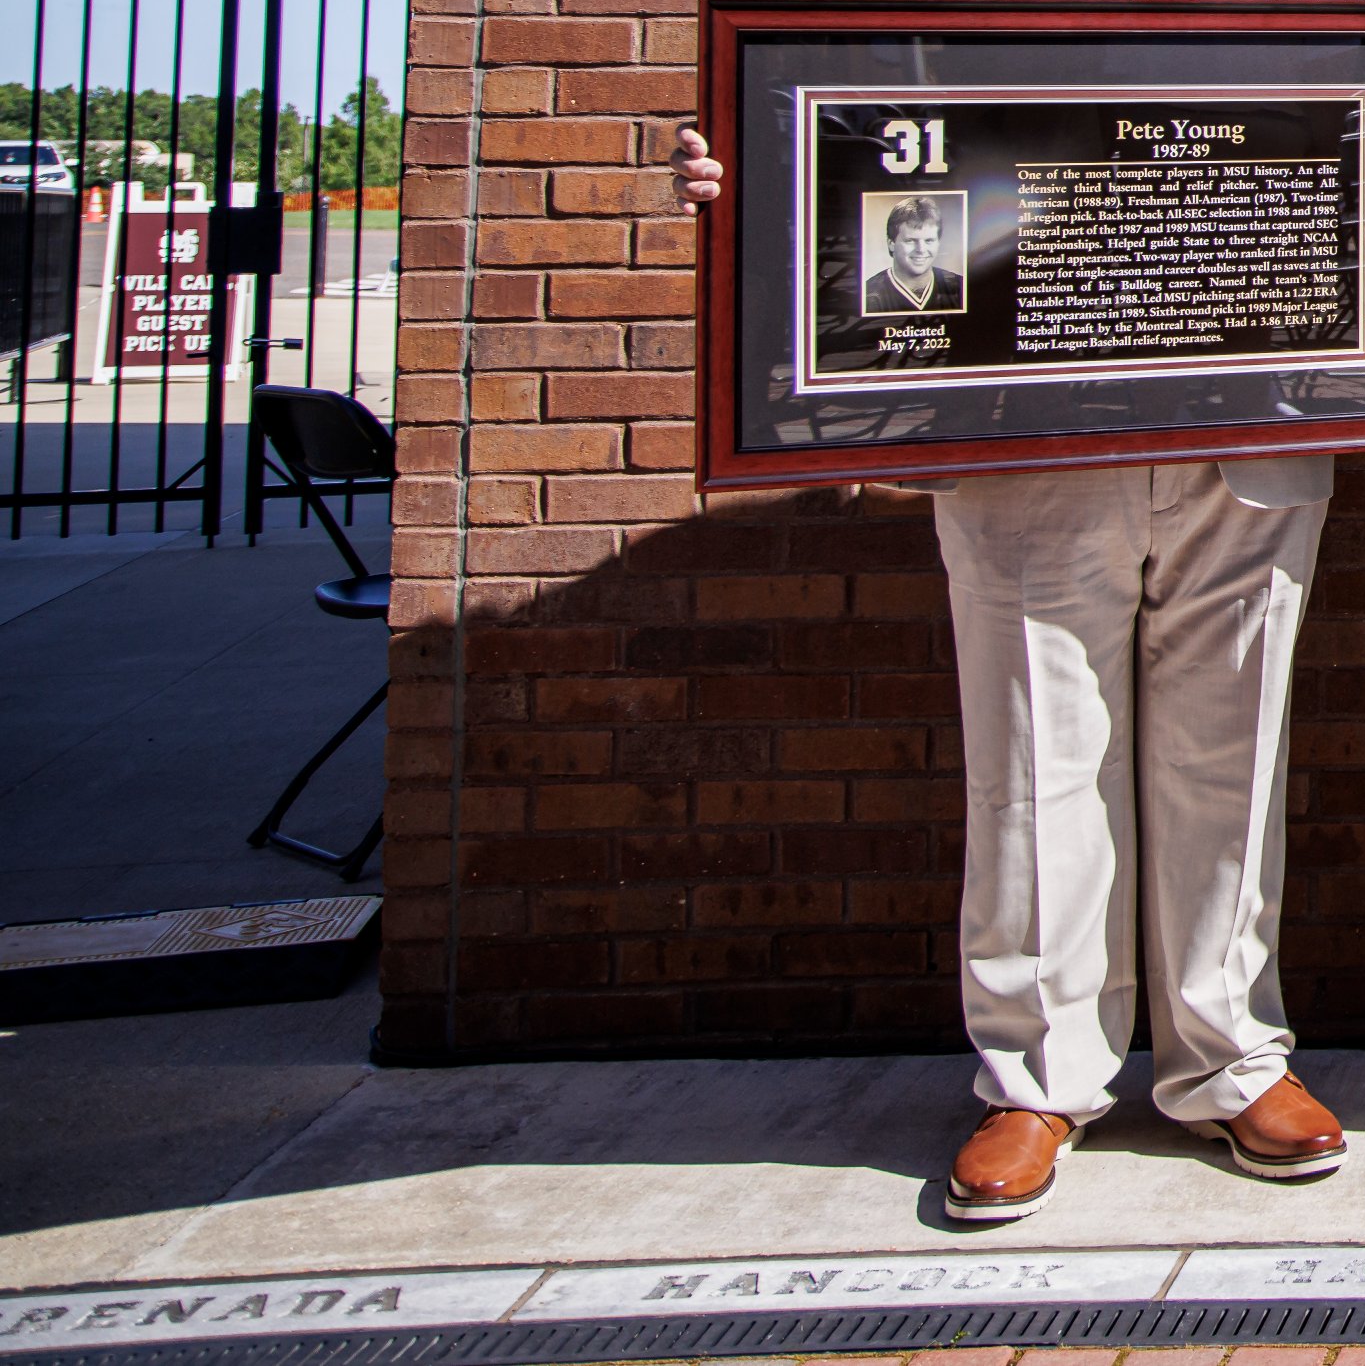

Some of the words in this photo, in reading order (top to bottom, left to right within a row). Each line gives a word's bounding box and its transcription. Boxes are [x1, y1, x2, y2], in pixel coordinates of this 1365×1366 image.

[1116, 120, 1164, 140] Pete
[1171, 119, 1245, 143] Young
[882, 120, 948, 173] 31
[1152, 144, 1210, 158] 1987-89
[1017, 169, 1041, 179] One
[1046, 168, 1058, 179] of
[1062, 168, 1080, 178] the
[1085, 168, 1111, 178] most
[1115, 167, 1162, 180] complete
[1167, 166, 1203, 179] players
[1207, 166, 1218, 176] in
[1223, 165, 1249, 176] MSU
[1254, 165, 1292, 178] history.
[1297, 164, 1313, 175] An
[1317, 164, 1338, 174] elite
[1017, 182, 1066, 193] defensive
[1074, 182, 1101, 192] third
[1108, 181, 1153, 192] baseman
[1160, 180, 1179, 191] and
[1186, 180, 1213, 190] relief
[1220, 179, 1258, 192] pitcher.
[1265, 178, 1313, 189] Two-time
[1320, 178, 1338, 188] All-
[1018, 196, 1069, 207] American
[1073, 195, 1123, 209] (1988-89).
[1127, 194, 1179, 205] Freshman
[1182, 193, 1250, 204] All-American
[1254, 192, 1287, 205] (1987).
[1290, 191, 1338, 202] Two-time
[885, 325, 945, 338] Dedicated
[879, 339, 906, 353] May
[908, 340, 920, 352] 7,
[923, 338, 950, 349] 2022
[643, 1264, 1064, 1299] HANCOCK
[0, 1286, 401, 1334] RENADA
